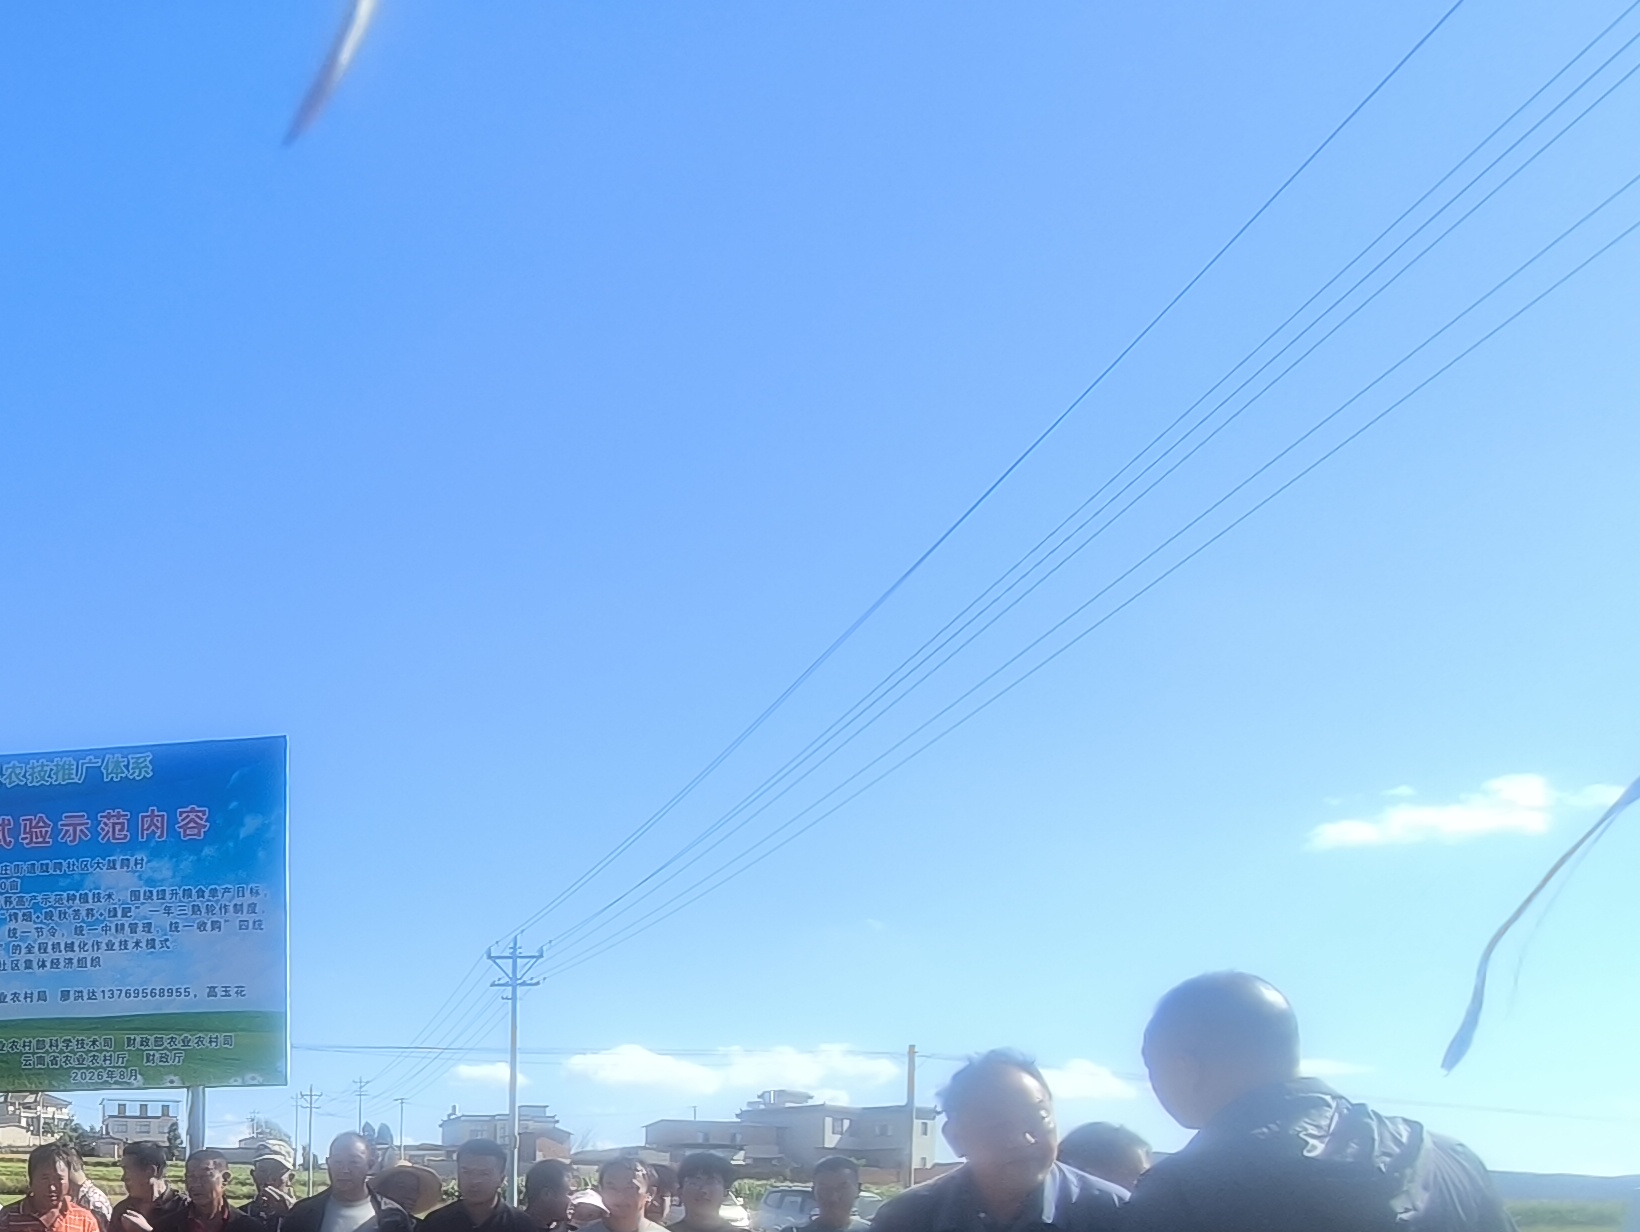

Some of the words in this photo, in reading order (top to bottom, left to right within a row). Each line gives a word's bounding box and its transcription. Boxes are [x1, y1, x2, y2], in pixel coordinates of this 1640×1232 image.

[143, 1050, 185, 1065] 财政厅
[71, 1068, 140, 1083] 2026年8月
